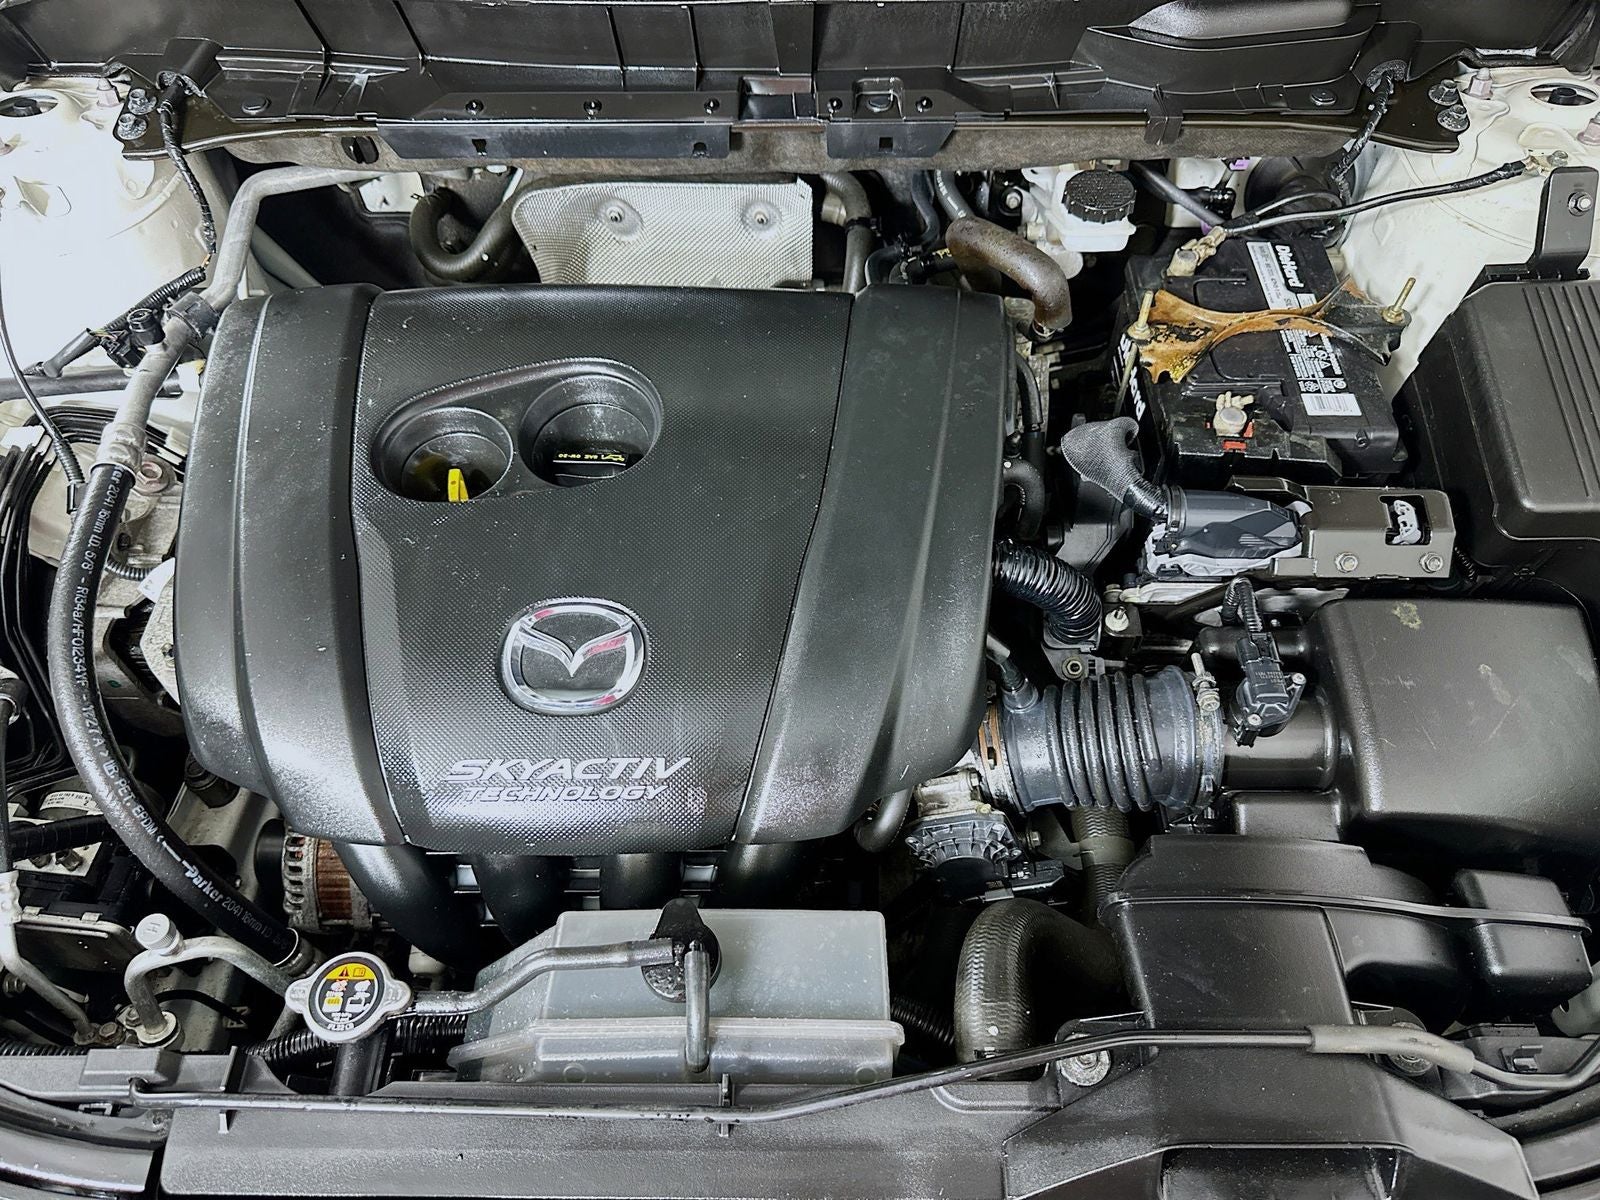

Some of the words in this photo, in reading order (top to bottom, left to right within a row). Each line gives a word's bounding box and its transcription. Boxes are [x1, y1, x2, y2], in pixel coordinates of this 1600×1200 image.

[103, 484, 120, 508] 2041
[443, 757, 692, 782] SKYACTIV
[464, 785, 670, 802] TECHNOLOGY
[182, 860, 224, 902] Parker
[221, 896, 243, 917] 2041
